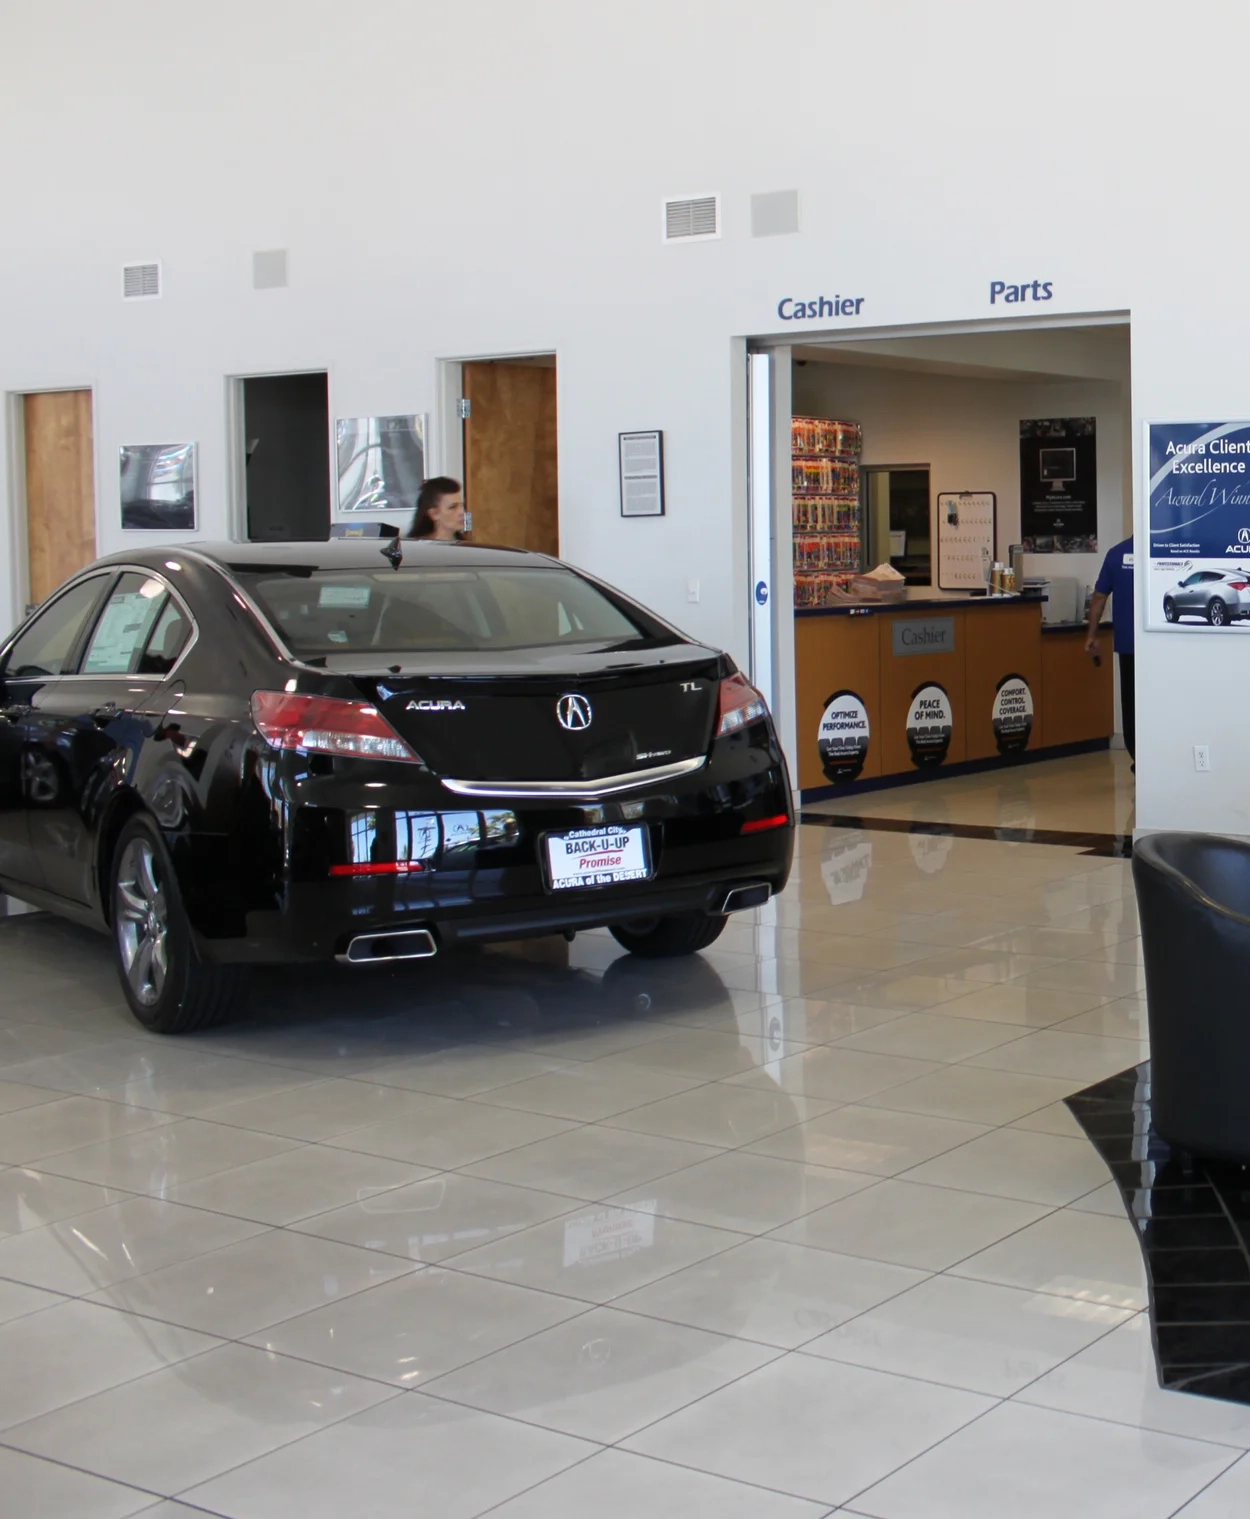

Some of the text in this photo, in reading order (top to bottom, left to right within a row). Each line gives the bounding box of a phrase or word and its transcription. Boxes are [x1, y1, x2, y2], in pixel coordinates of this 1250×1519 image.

[989, 280, 1053, 304] Parts
[777, 294, 865, 320] Cashier
[1165, 440, 1206, 455] Acura
[1172, 458, 1246, 474] Excellence
[1154, 479, 1216, 507] Award
[901, 626, 947, 646] Cashier
[680, 682, 703, 692] TL
[1001, 688, 1026, 697] COMFORT.
[406, 700, 466, 710] ACURA
[919, 699, 940, 709] PEACE
[1000, 697, 1026, 706] CONTROL.
[831, 711, 858, 720] OPTIMIZE
[914, 709, 946, 720] OF MIND.
[999, 705, 1027, 715] COVERAGE.
[822, 721, 867, 731] PERFORMANCE.
[568, 826, 624, 839] Cathedral City
[565, 836, 630, 855] BACK-U-UP
[579, 855, 622, 869] Promise
[552, 868, 647, 890] ACURA of the DESERT
